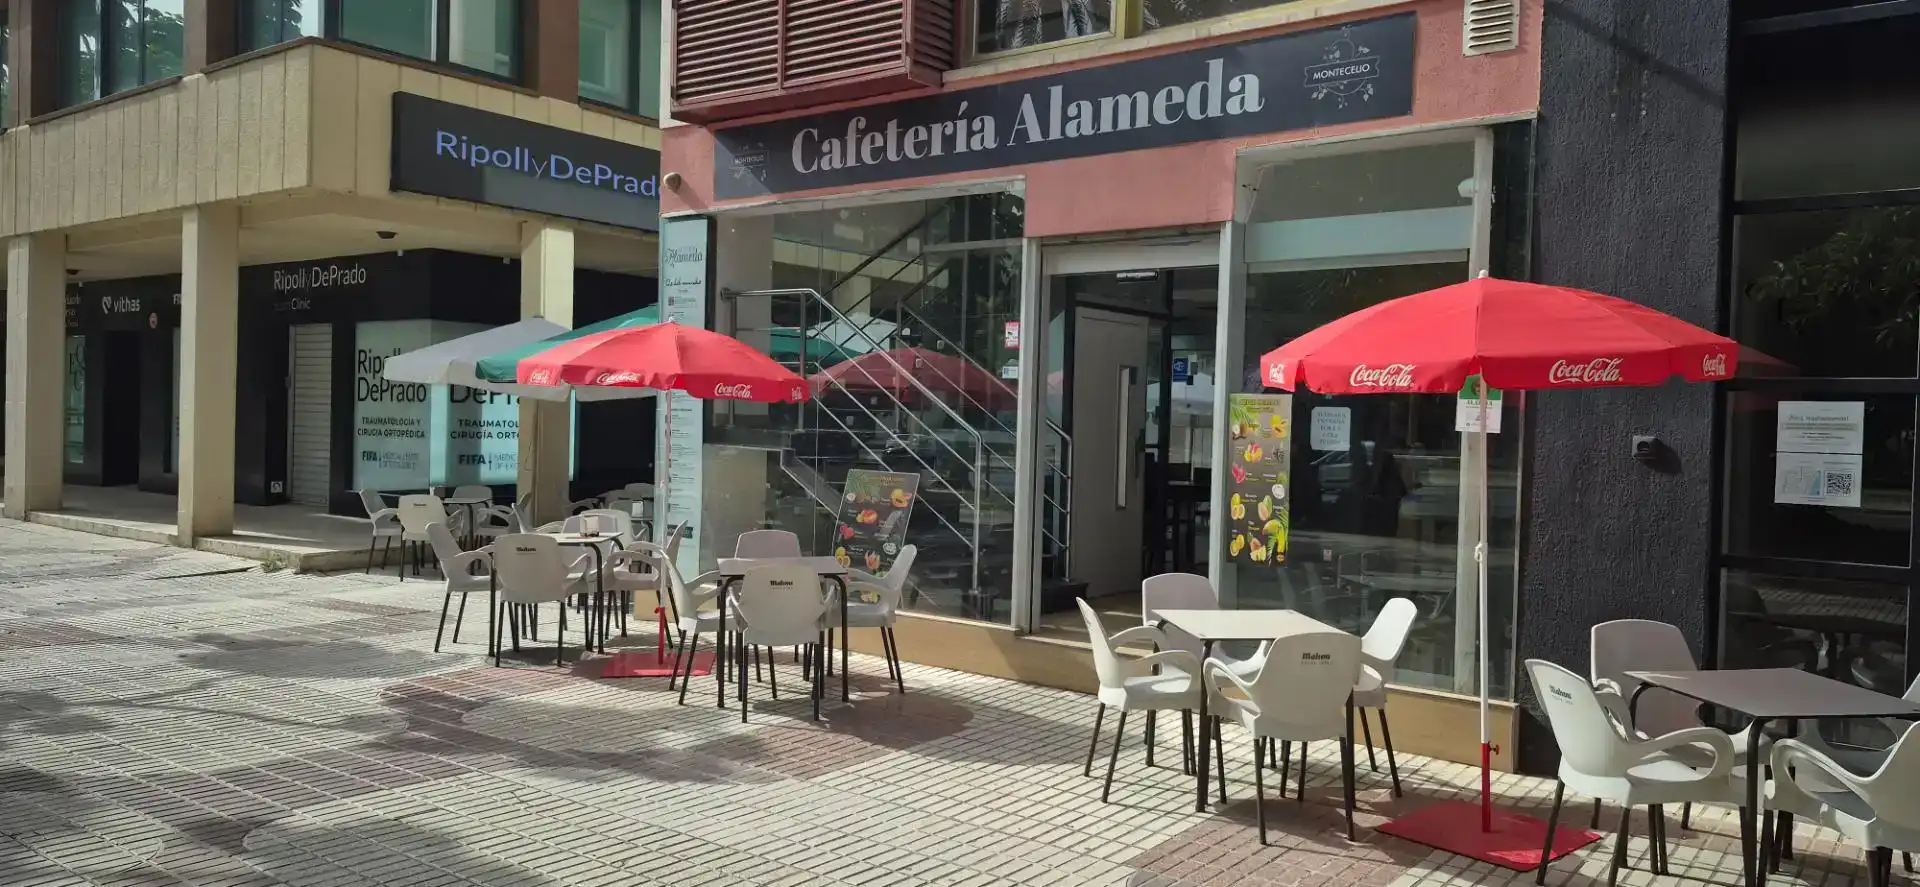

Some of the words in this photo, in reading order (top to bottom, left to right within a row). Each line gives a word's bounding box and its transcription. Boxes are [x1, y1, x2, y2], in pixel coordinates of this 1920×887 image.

[1312, 63, 1370, 80] MONTECELIO
[791, 101, 999, 174] Cafetería
[1006, 58, 1266, 146] Alameda
[436, 128, 661, 198] RipollyDePrad
[113, 296, 141, 313] vithas
[1350, 363, 1415, 388] Coca-Cola
[1549, 357, 1624, 384] Coca-Cola
[714, 382, 753, 400] Coca-Cola
[362, 450, 378, 462] FIFA
[458, 454, 486, 465] FIFA
